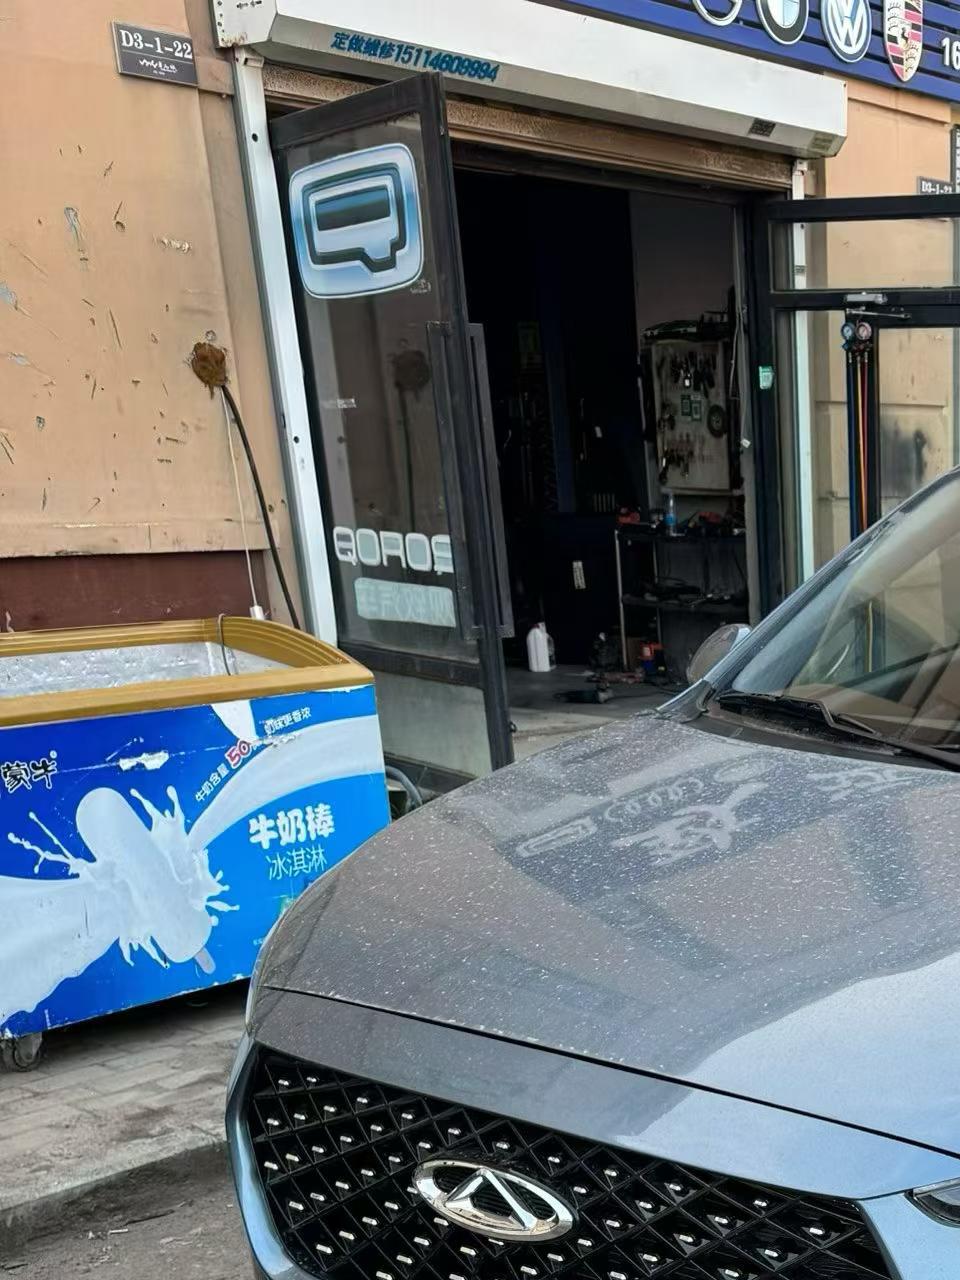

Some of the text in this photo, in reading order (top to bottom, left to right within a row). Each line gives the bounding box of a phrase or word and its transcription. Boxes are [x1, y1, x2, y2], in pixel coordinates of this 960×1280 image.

[119, 29, 193, 60] D3-1-22
[333, 526, 454, 575] QOROS
[1, 757, 58, 793] 蒙牛
[195, 763, 230, 802] 牛奶含量
[264, 707, 312, 737] 奶味更香浓
[248, 803, 335, 849] 牛奶棒
[266, 844, 327, 880] 冰淇淋
